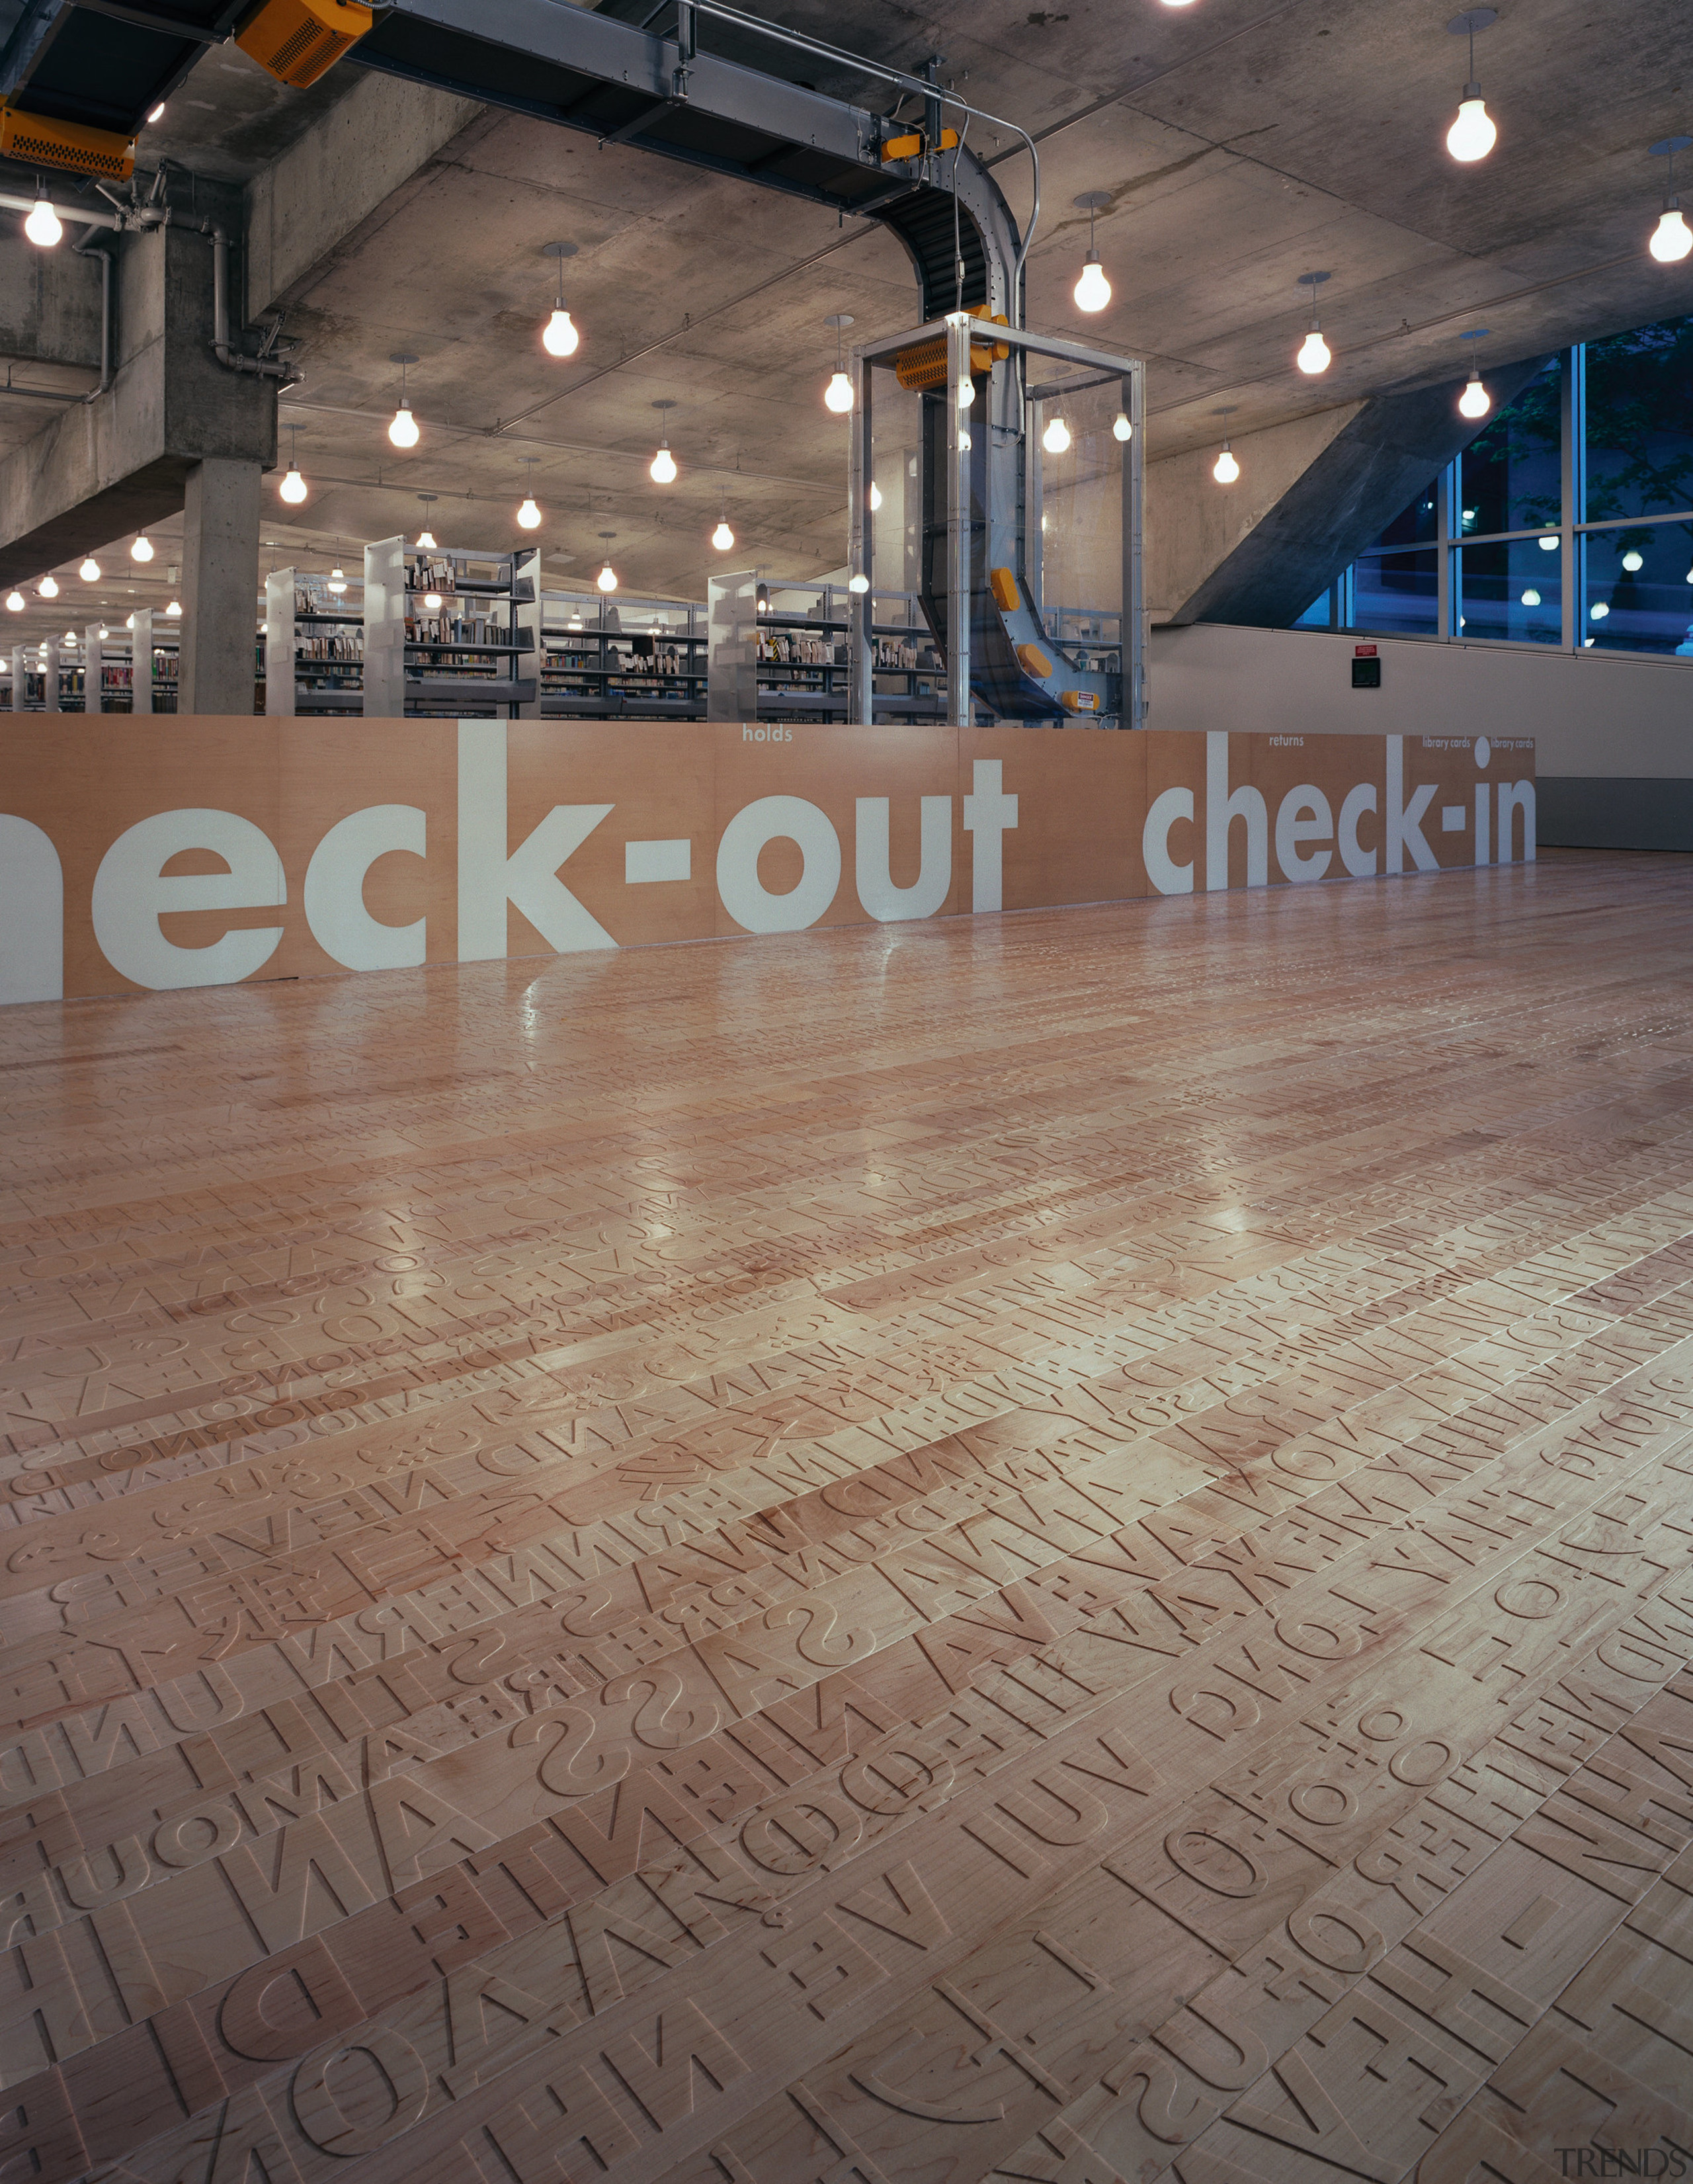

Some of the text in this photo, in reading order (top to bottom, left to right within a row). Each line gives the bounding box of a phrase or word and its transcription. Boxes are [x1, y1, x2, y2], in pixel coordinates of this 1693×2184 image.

[743, 723, 792, 741] holds
[1270, 734, 1303, 746] returns
[1423, 735, 1471, 751] library cards
[1491, 737, 1534, 751] library cards
[1143, 731, 1536, 895] check-in
[0, 719, 1018, 1004] eck-out
